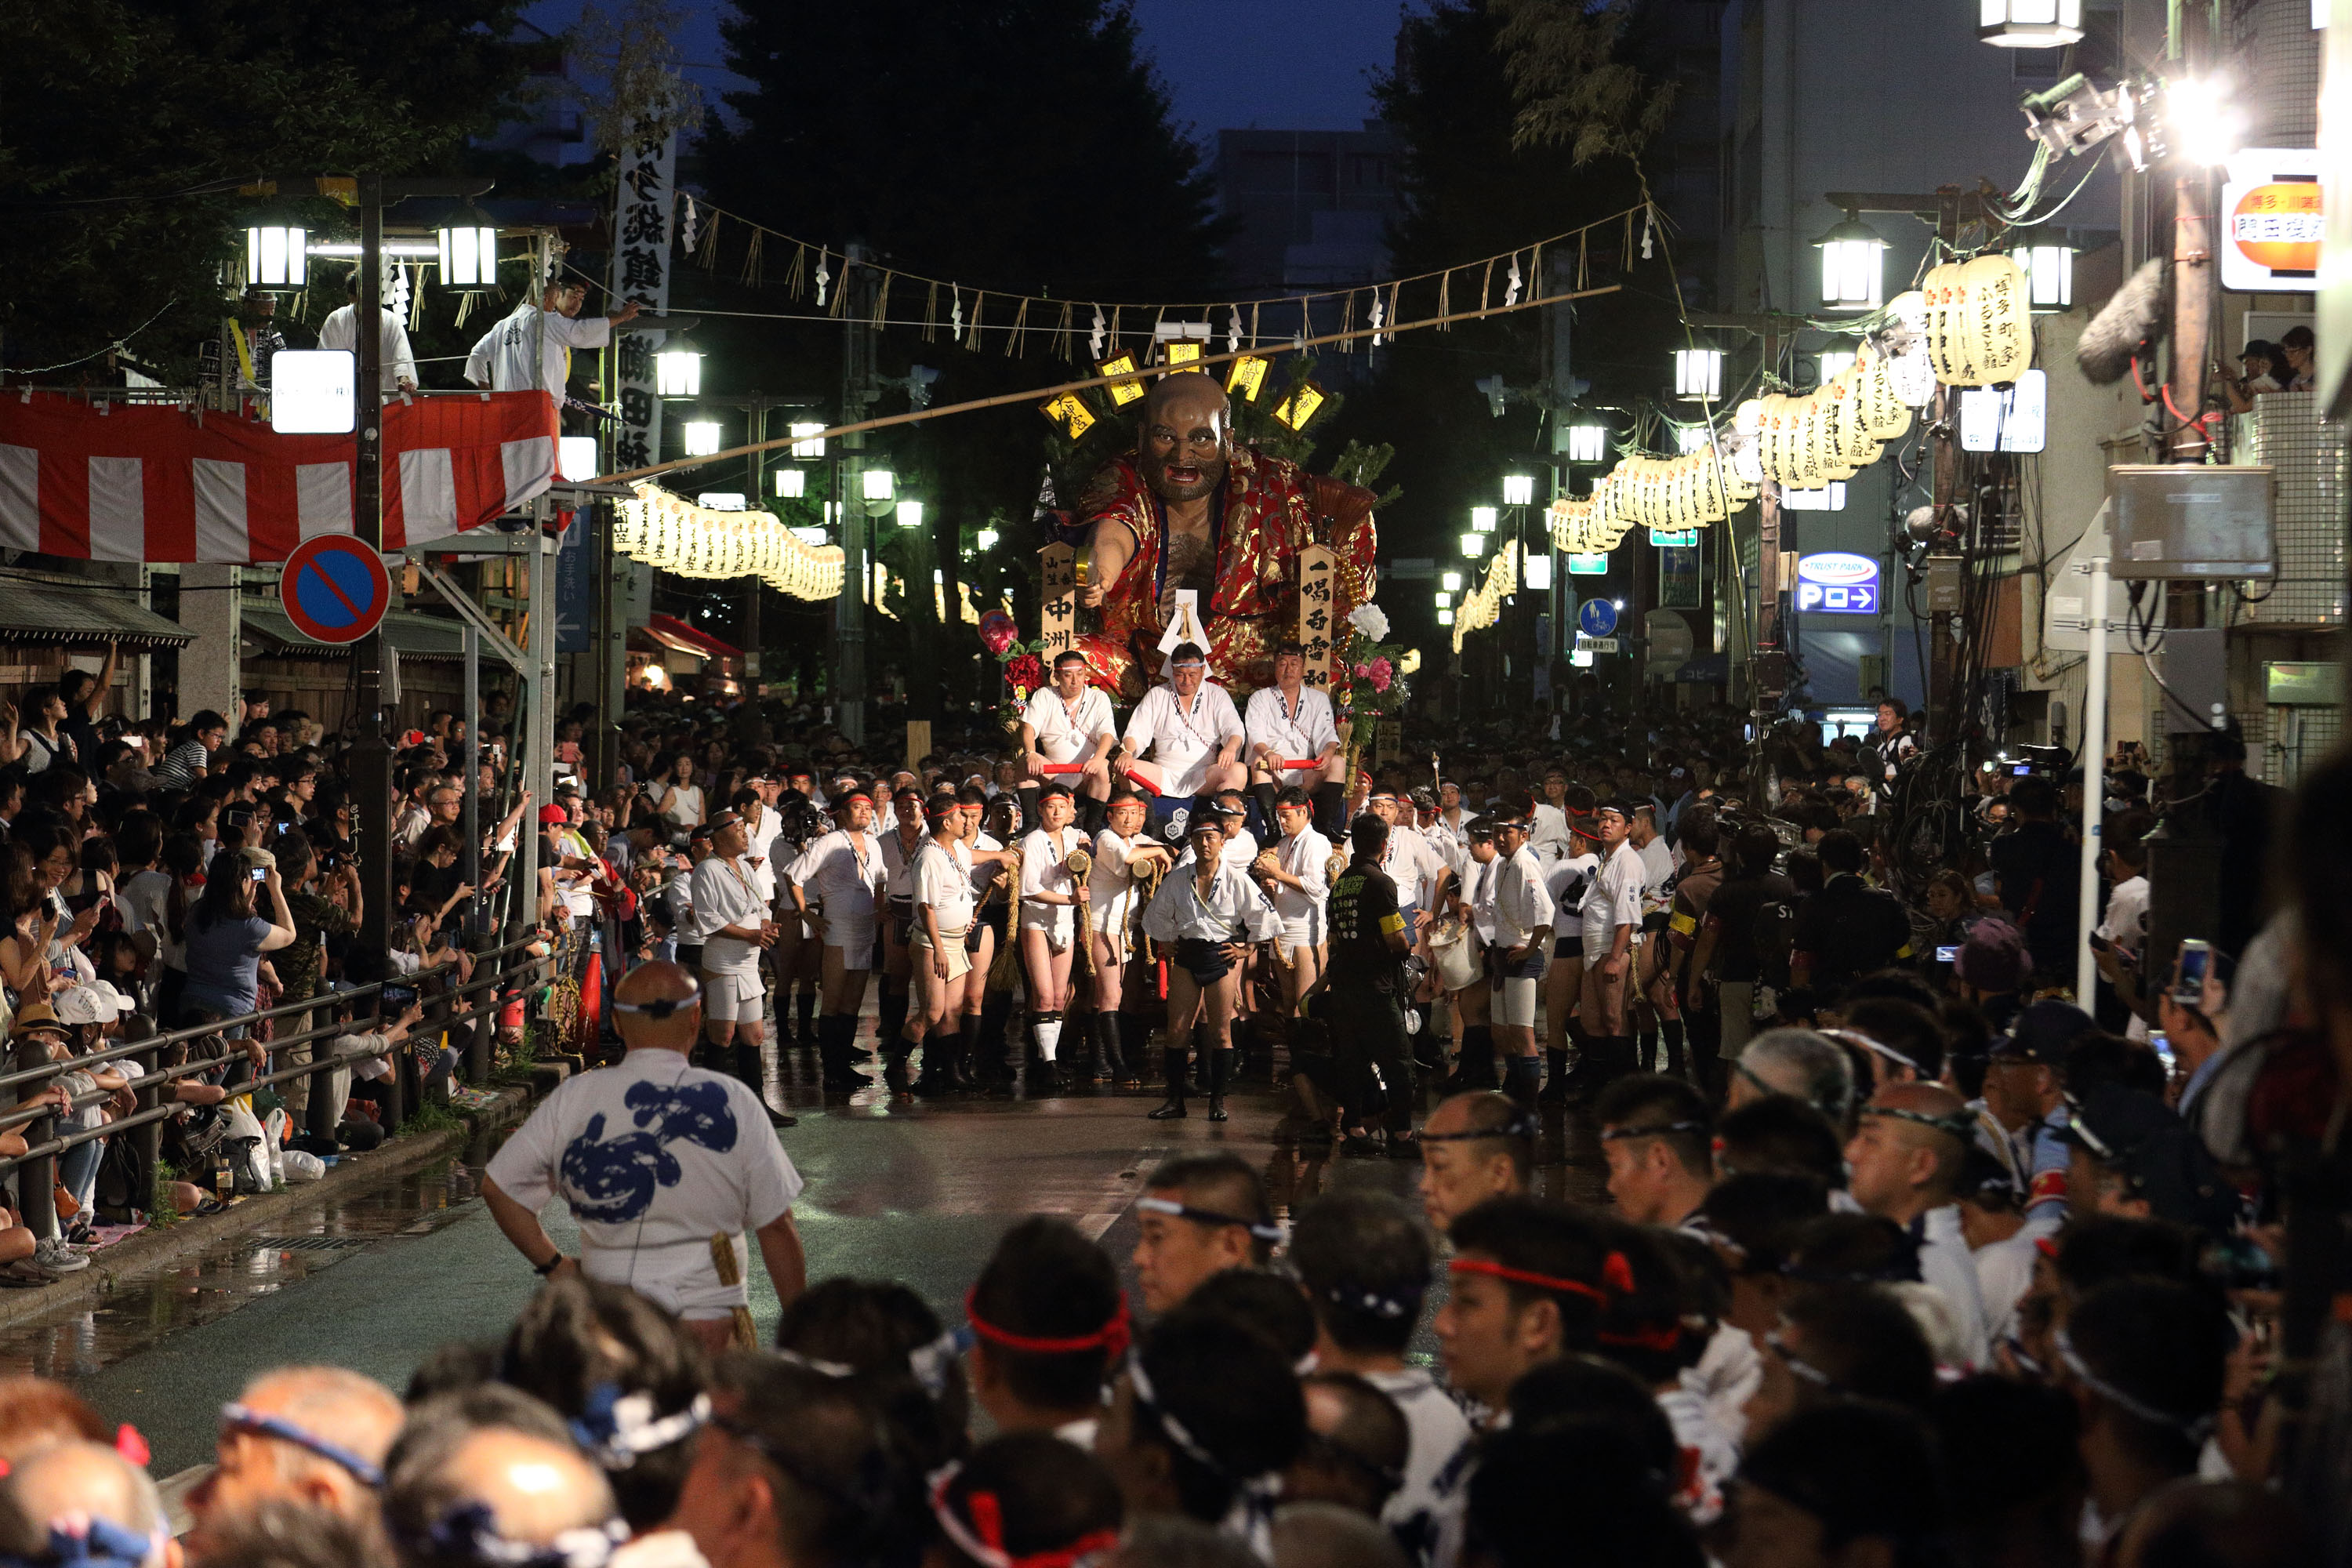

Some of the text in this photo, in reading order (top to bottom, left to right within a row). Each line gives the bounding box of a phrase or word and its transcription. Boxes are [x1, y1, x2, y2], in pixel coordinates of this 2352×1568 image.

[1977, 286, 1998, 370] ふるさと館
[564, 550, 577, 602] お手洗い
[1809, 562, 1864, 572] TRUST PARK
[1799, 584, 1823, 611] P
